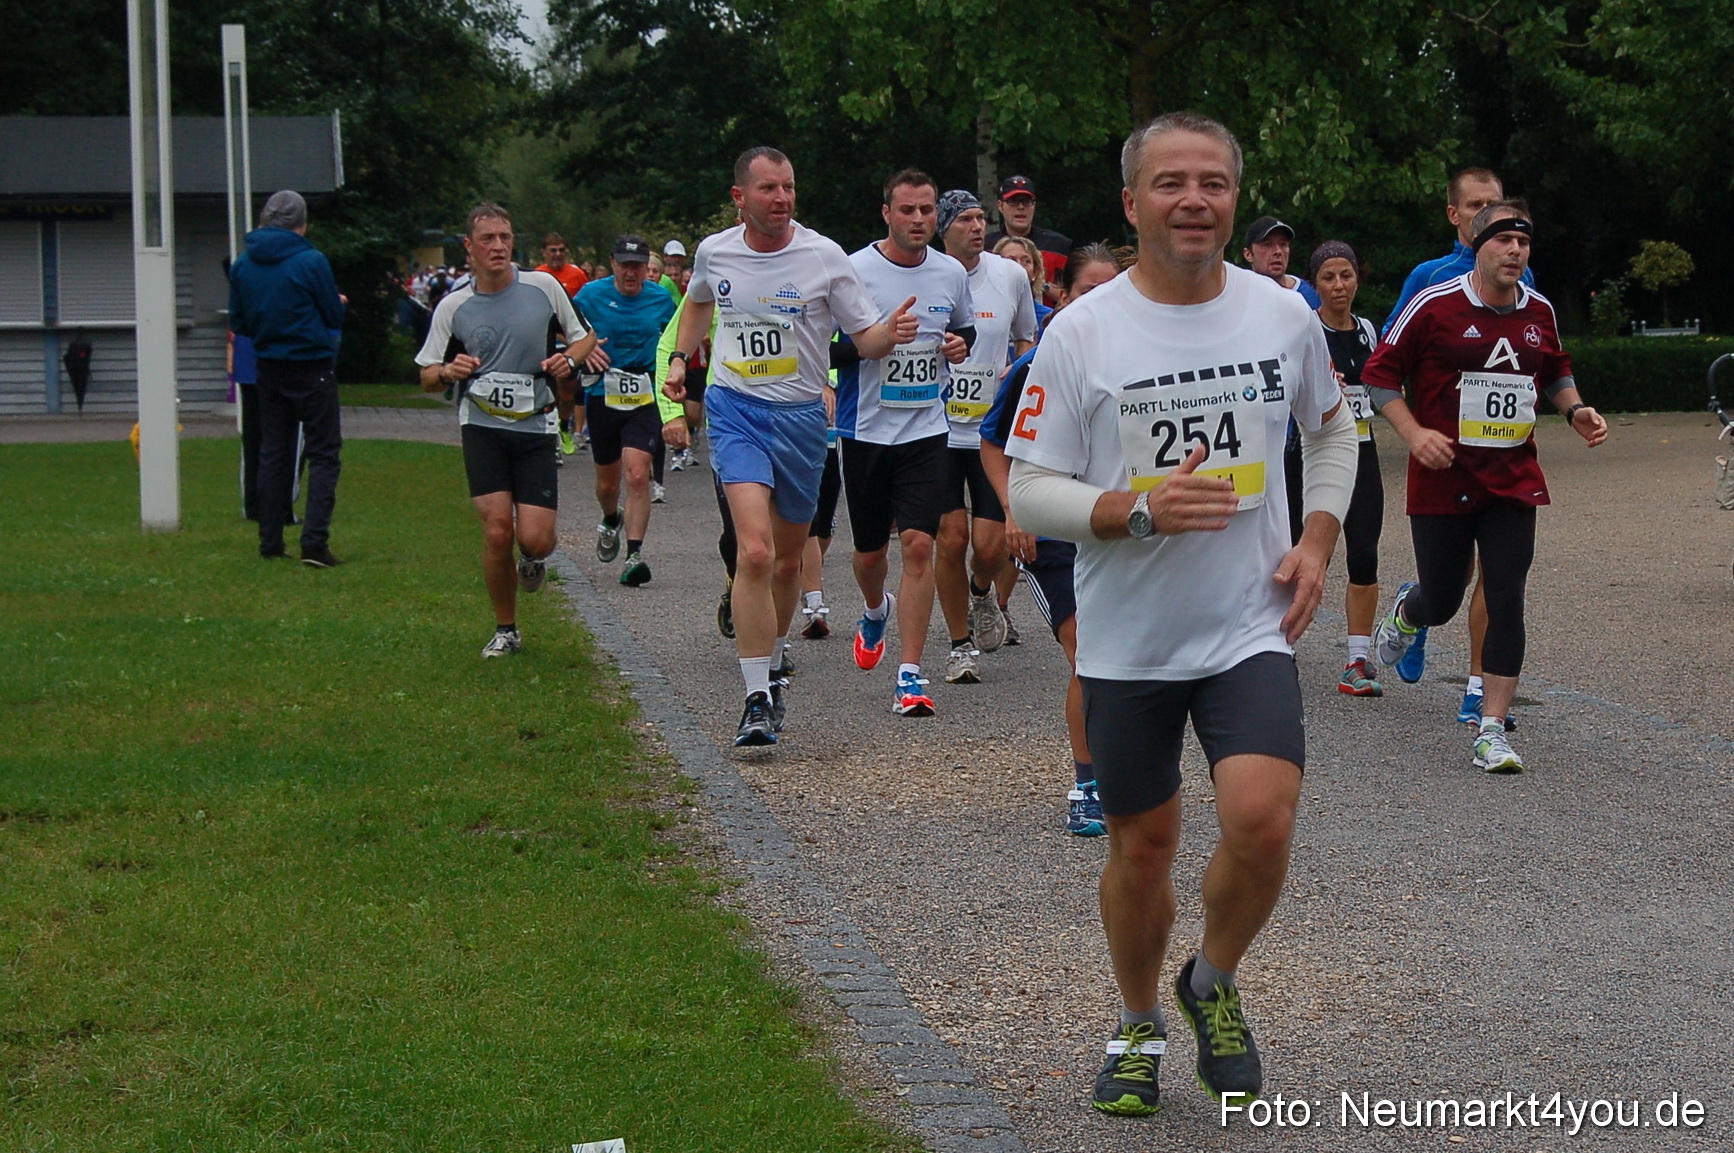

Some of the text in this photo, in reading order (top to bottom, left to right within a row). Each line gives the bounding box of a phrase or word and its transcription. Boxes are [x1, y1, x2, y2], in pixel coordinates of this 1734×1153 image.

[724, 321, 742, 329] PARTL
[736, 329, 782, 358] 160
[906, 347, 935, 357] Neumarkt
[750, 363, 768, 375] Ulli
[887, 358, 938, 383] 2436
[954, 368, 985, 377] Neumarkt
[619, 378, 641, 394] 65
[1463, 379, 1525, 390] PARTL Neumarkt
[488, 387, 515, 409] 45
[900, 389, 929, 400] Robert
[951, 404, 970, 415] Uwe
[1120, 391, 1238, 416] PARTL Neumarkt
[1486, 391, 1517, 419] 68
[1013, 385, 1046, 441] 2
[1482, 425, 1515, 437] Martin
[1151, 411, 1242, 469] 254
